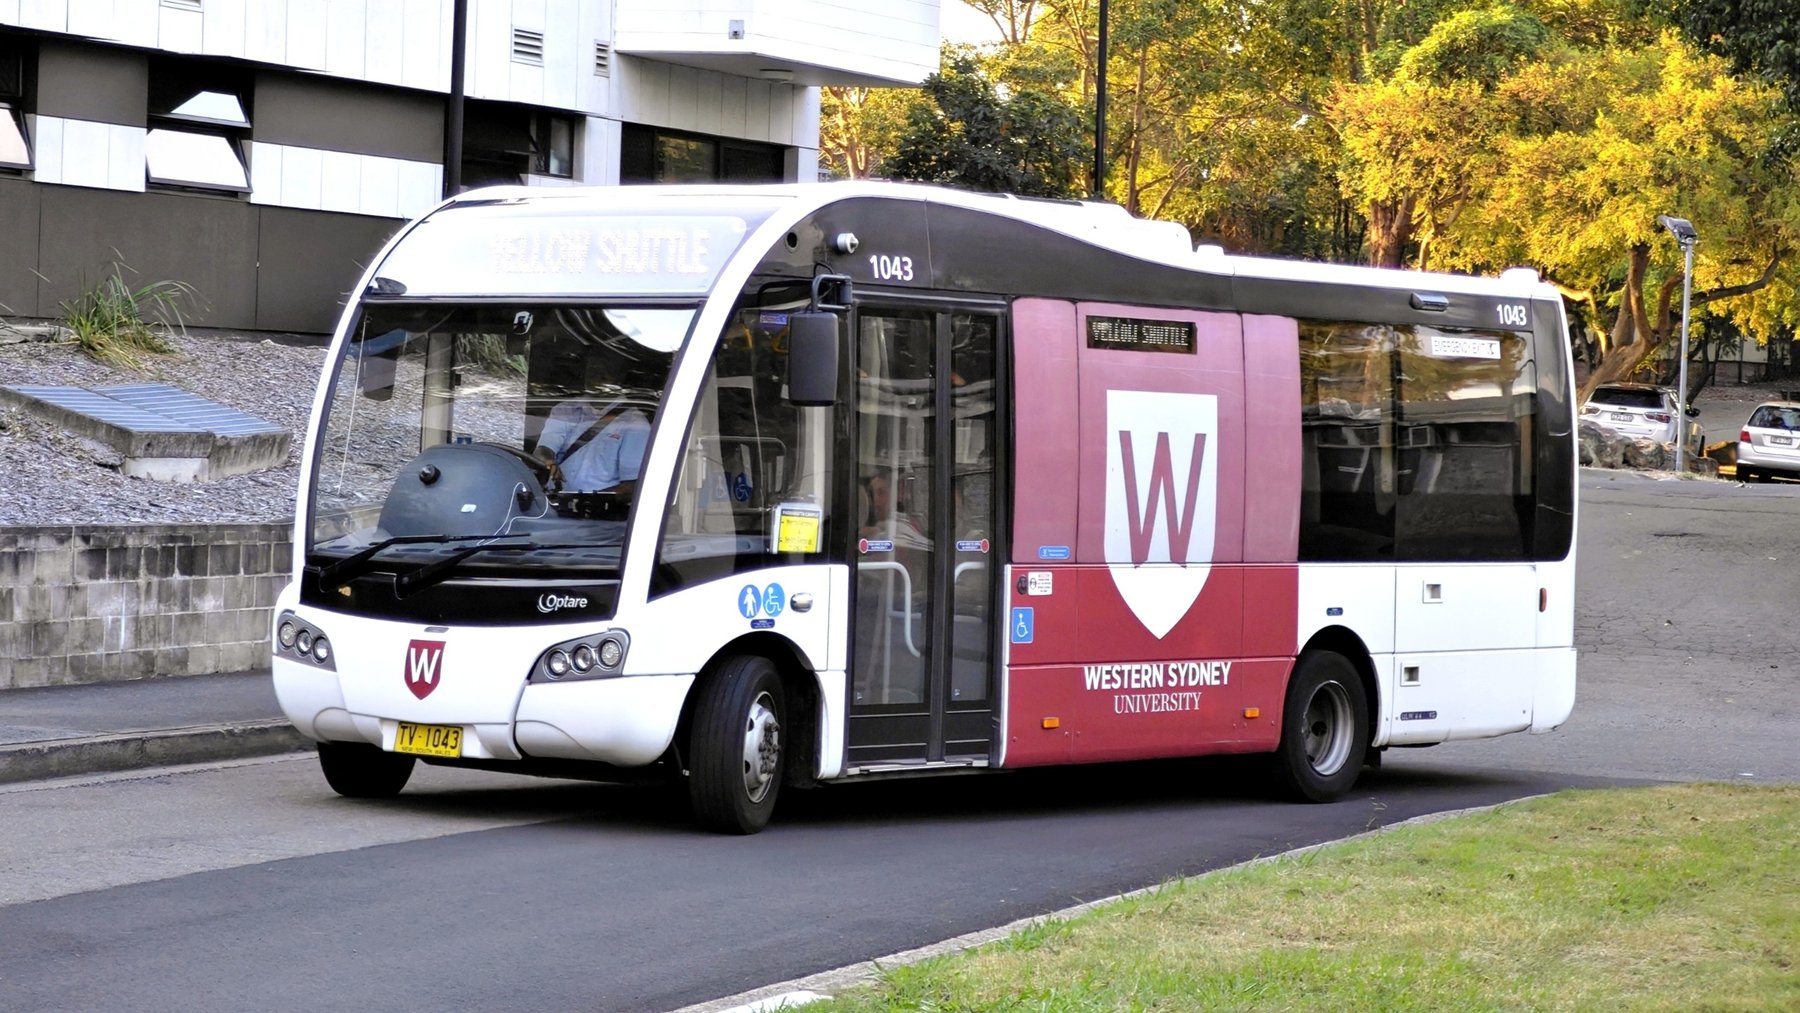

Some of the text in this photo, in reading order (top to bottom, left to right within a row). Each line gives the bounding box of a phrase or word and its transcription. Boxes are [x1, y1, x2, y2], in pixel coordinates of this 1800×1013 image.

[596, 227, 711, 274] SHUTTLE
[869, 254, 914, 281] 1043
[1496, 304, 1527, 326] 1043
[1118, 430, 1207, 568] W
[543, 594, 588, 612] Optare
[410, 647, 441, 684] W
[1083, 661, 1232, 691] WESTERN SYDNEY
[1113, 692, 1202, 714] UNIVERSITY
